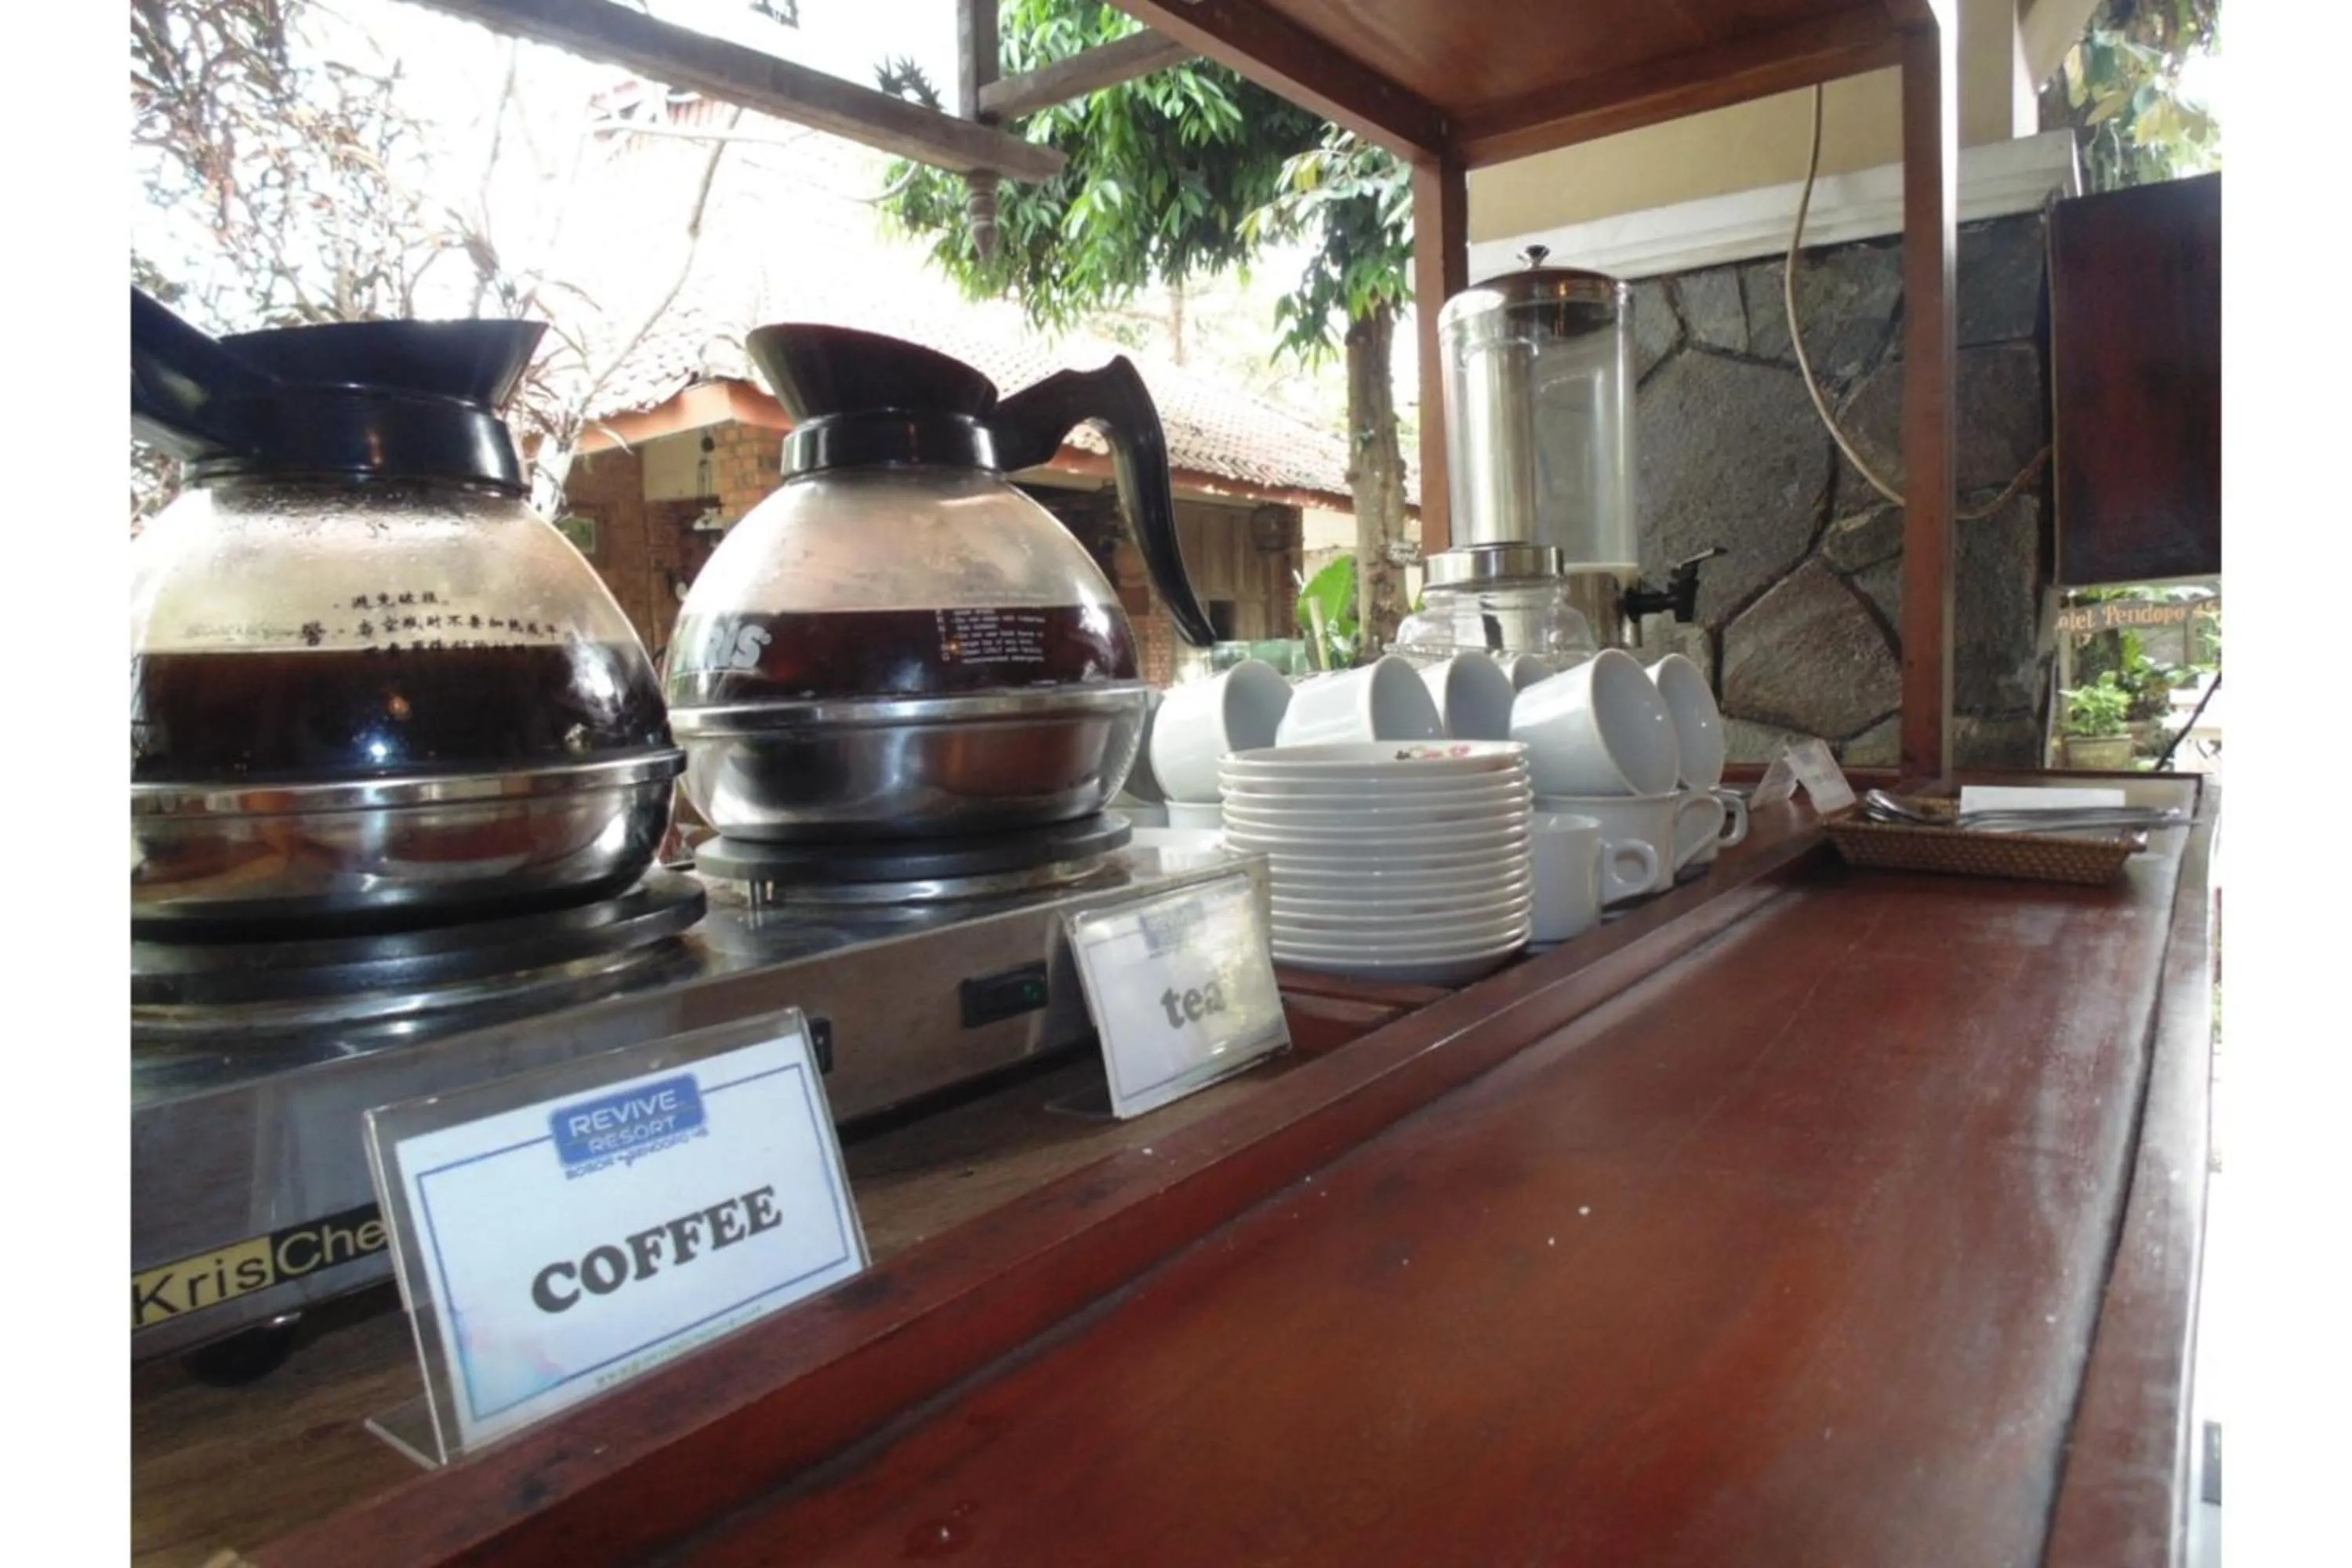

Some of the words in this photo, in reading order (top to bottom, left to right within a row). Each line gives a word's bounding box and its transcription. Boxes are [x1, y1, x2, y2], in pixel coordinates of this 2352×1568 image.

[2056, 609, 2095, 630] otel
[2103, 602, 2186, 626] Pendopo
[1160, 980, 1228, 1030] tea
[568, 1088, 678, 1138] REVIVE
[589, 1115, 677, 1154] RESORT
[531, 1185, 783, 1314] COFFEE
